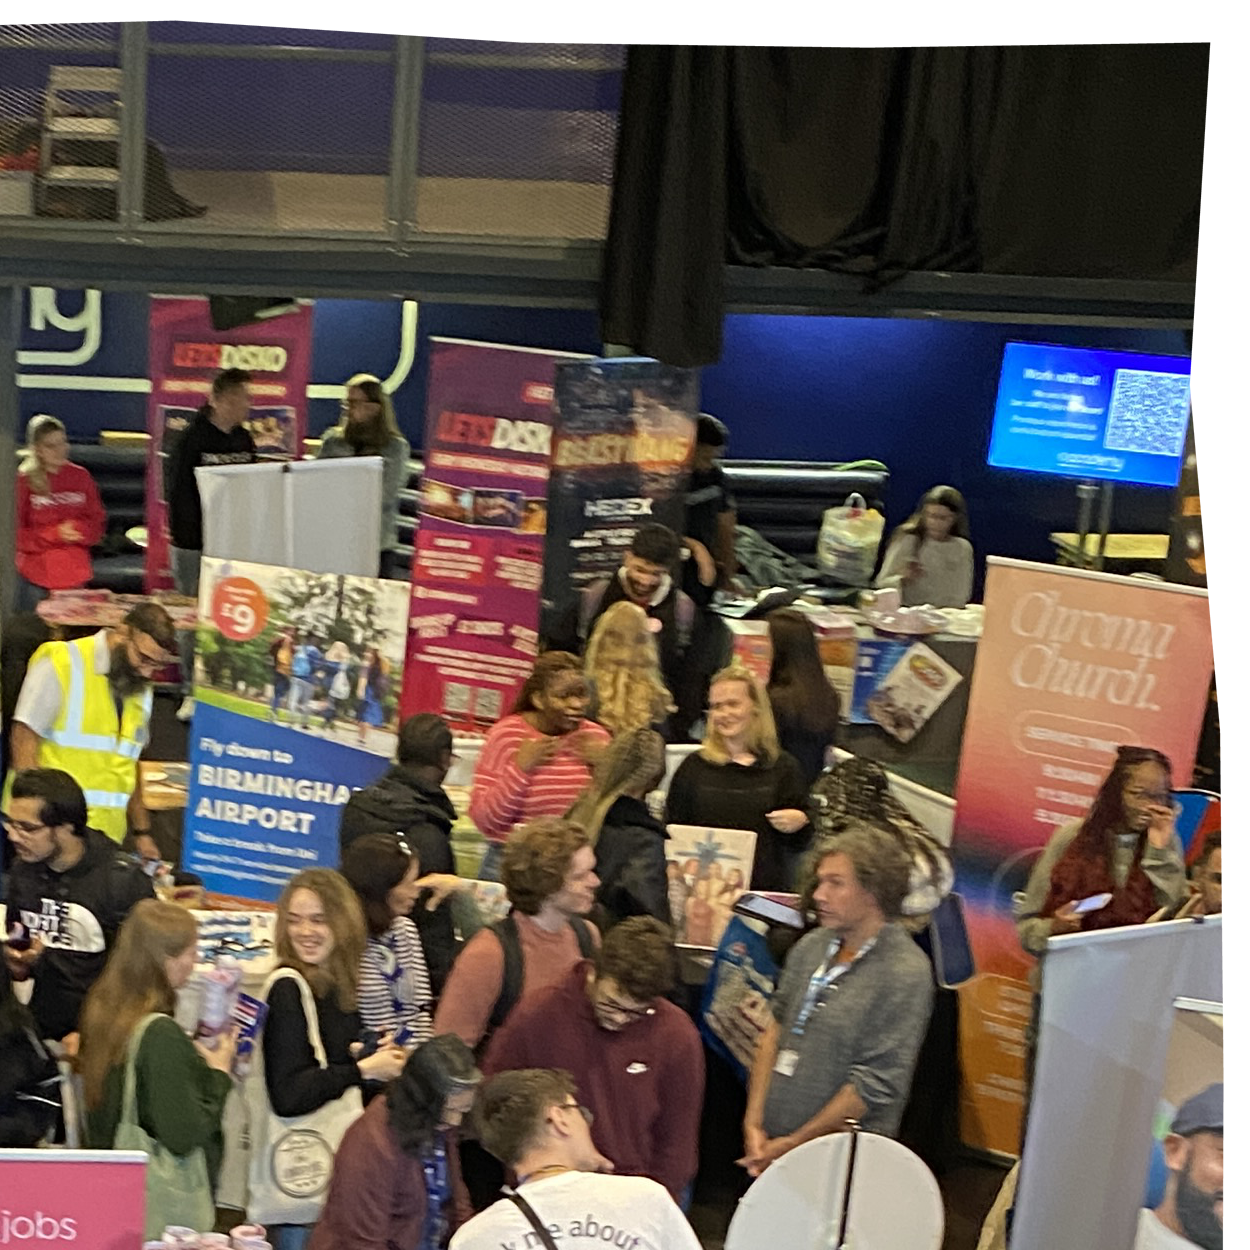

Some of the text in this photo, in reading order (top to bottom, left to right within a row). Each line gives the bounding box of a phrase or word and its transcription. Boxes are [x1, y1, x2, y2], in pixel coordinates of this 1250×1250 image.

[199, 737, 294, 764] Fly down to
[198, 763, 362, 806] BIRMINGHA
[195, 797, 316, 835] AIRPORT
[523, 1223, 563, 1250] me
